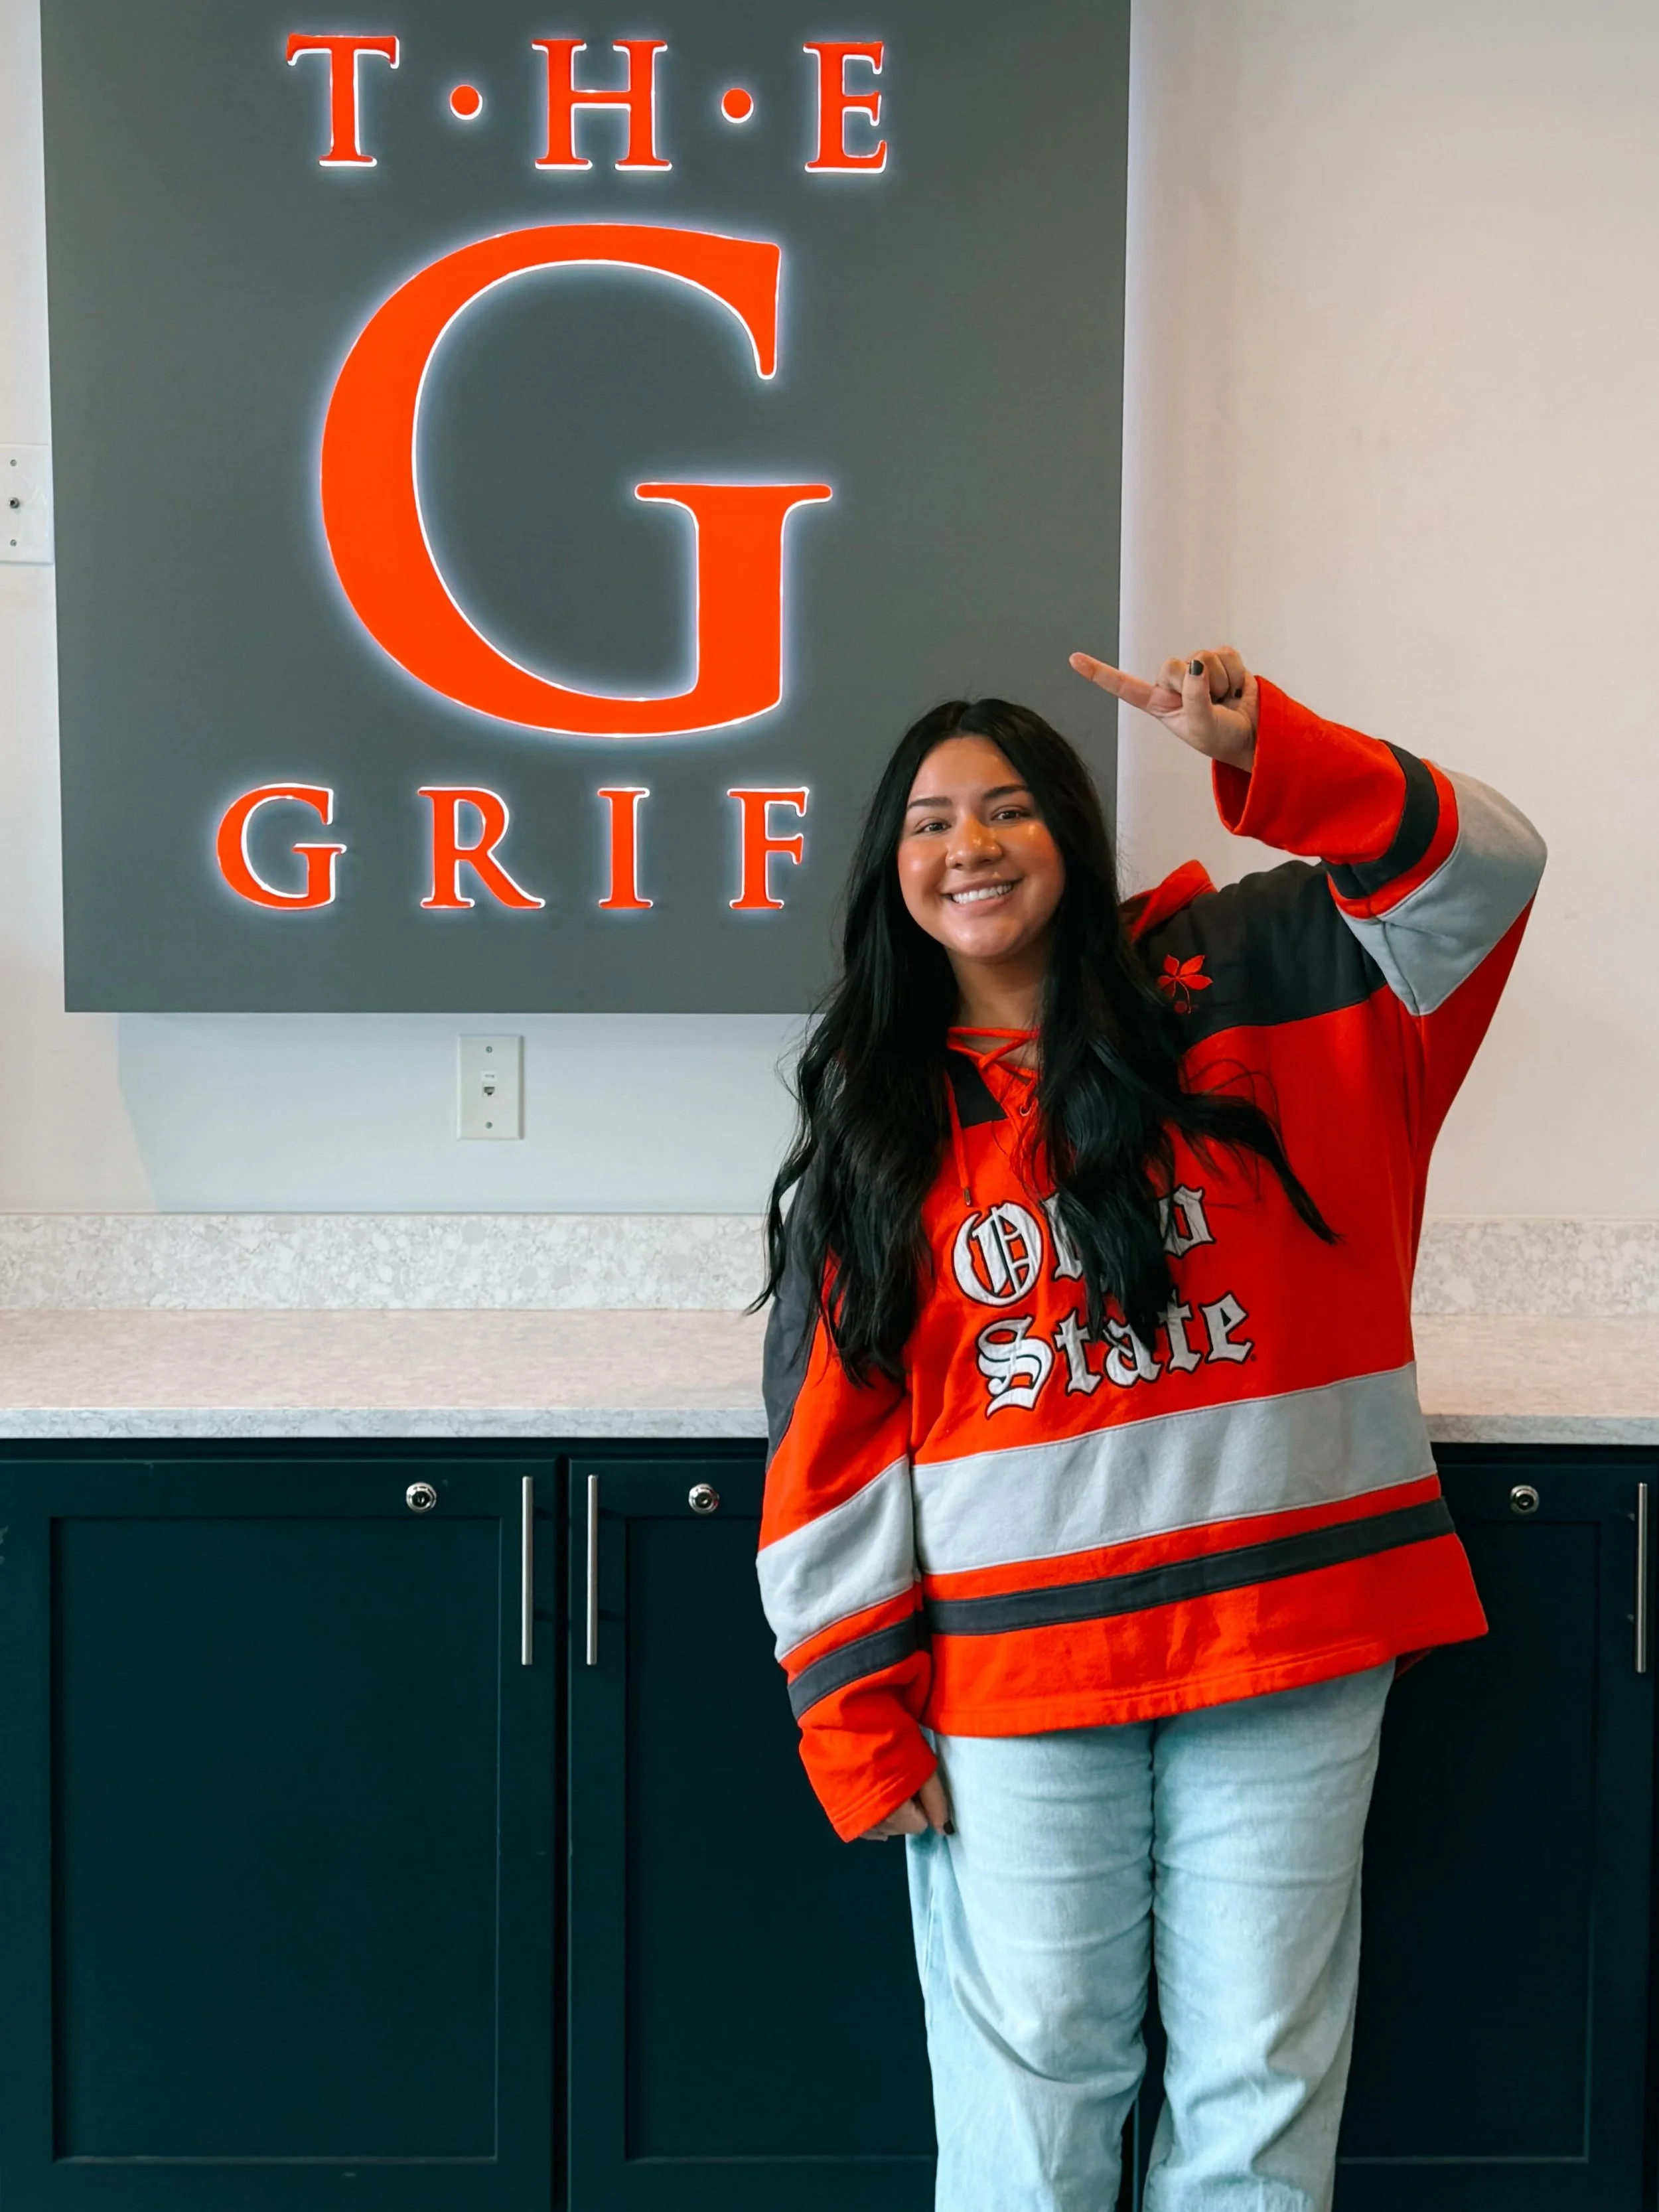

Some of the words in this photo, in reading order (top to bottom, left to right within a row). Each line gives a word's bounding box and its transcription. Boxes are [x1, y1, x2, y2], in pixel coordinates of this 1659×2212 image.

[320, 222, 833, 738] G
[952, 1185, 1216, 1307] Oo
[975, 1288, 1254, 1419] State
